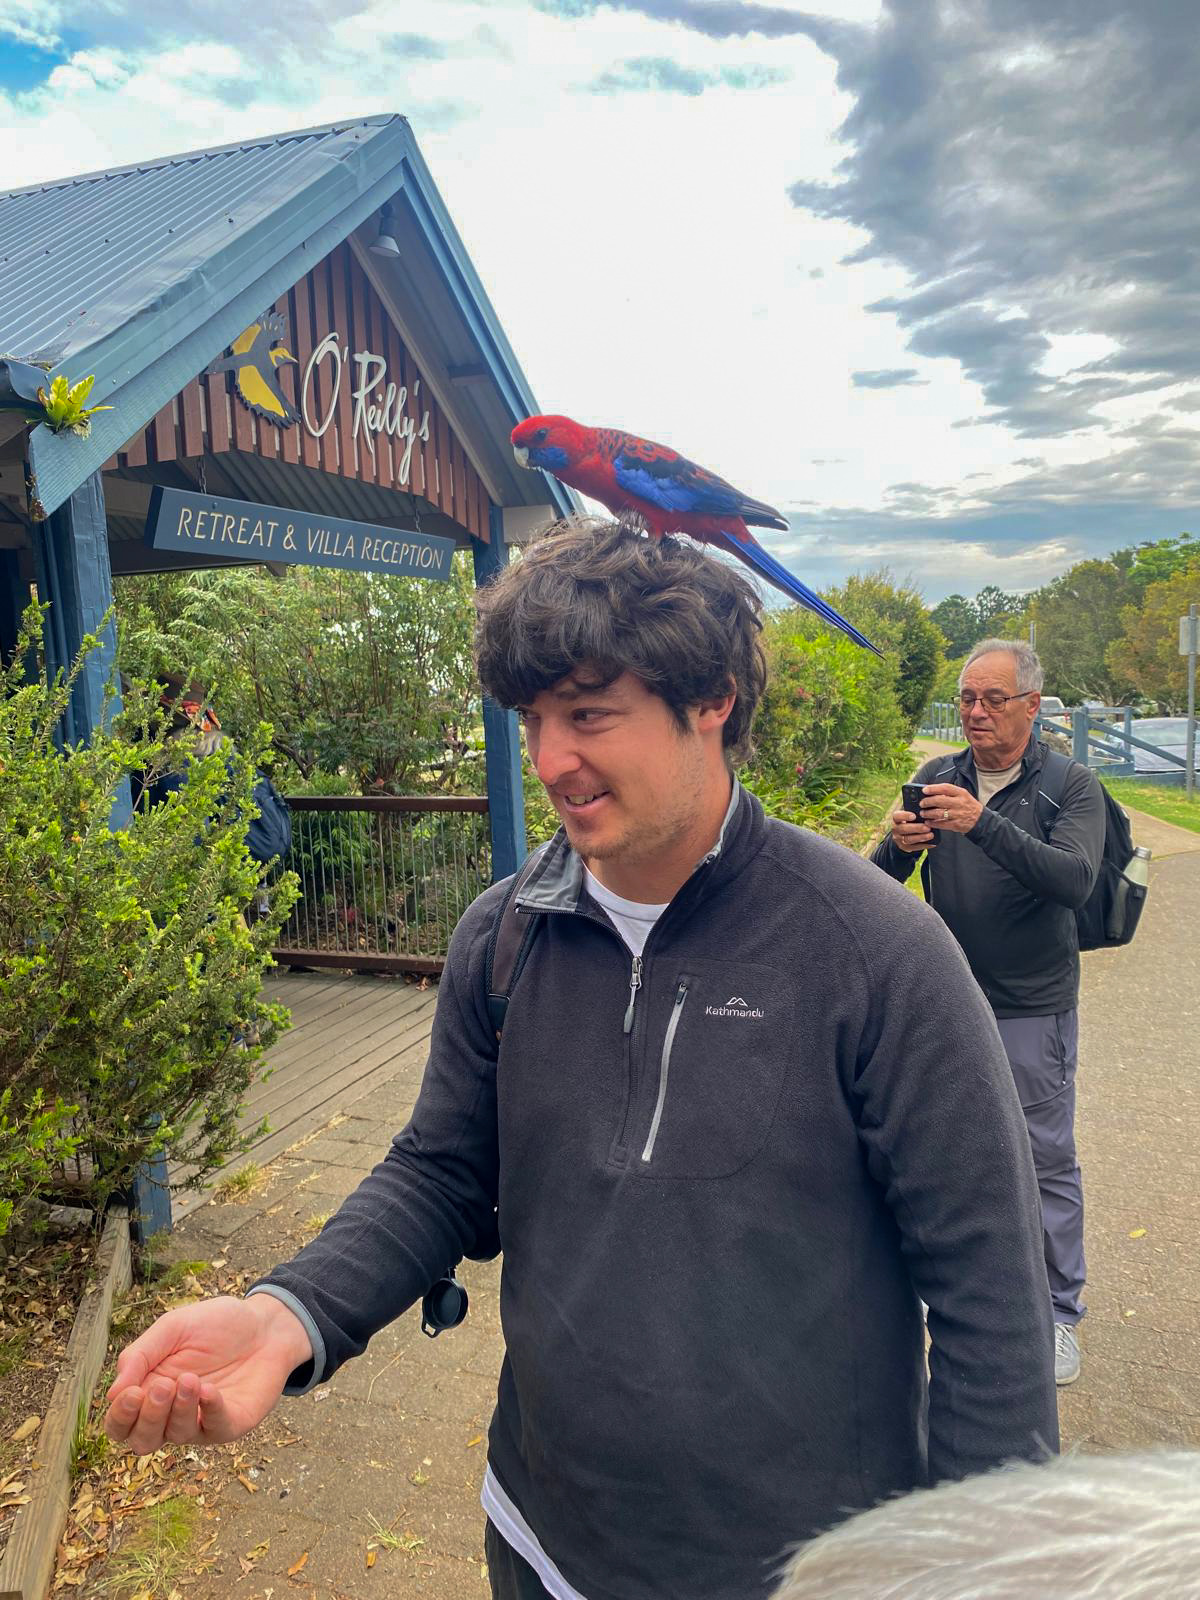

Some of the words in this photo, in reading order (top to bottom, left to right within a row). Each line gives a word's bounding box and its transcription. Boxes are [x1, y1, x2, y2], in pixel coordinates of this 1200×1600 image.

[177, 508, 278, 547] RETREAT
[283, 524, 297, 550] &
[307, 528, 355, 559] VILLA
[361, 537, 444, 570] RECEPTION
[706, 1005, 765, 1018] Kathmandu
